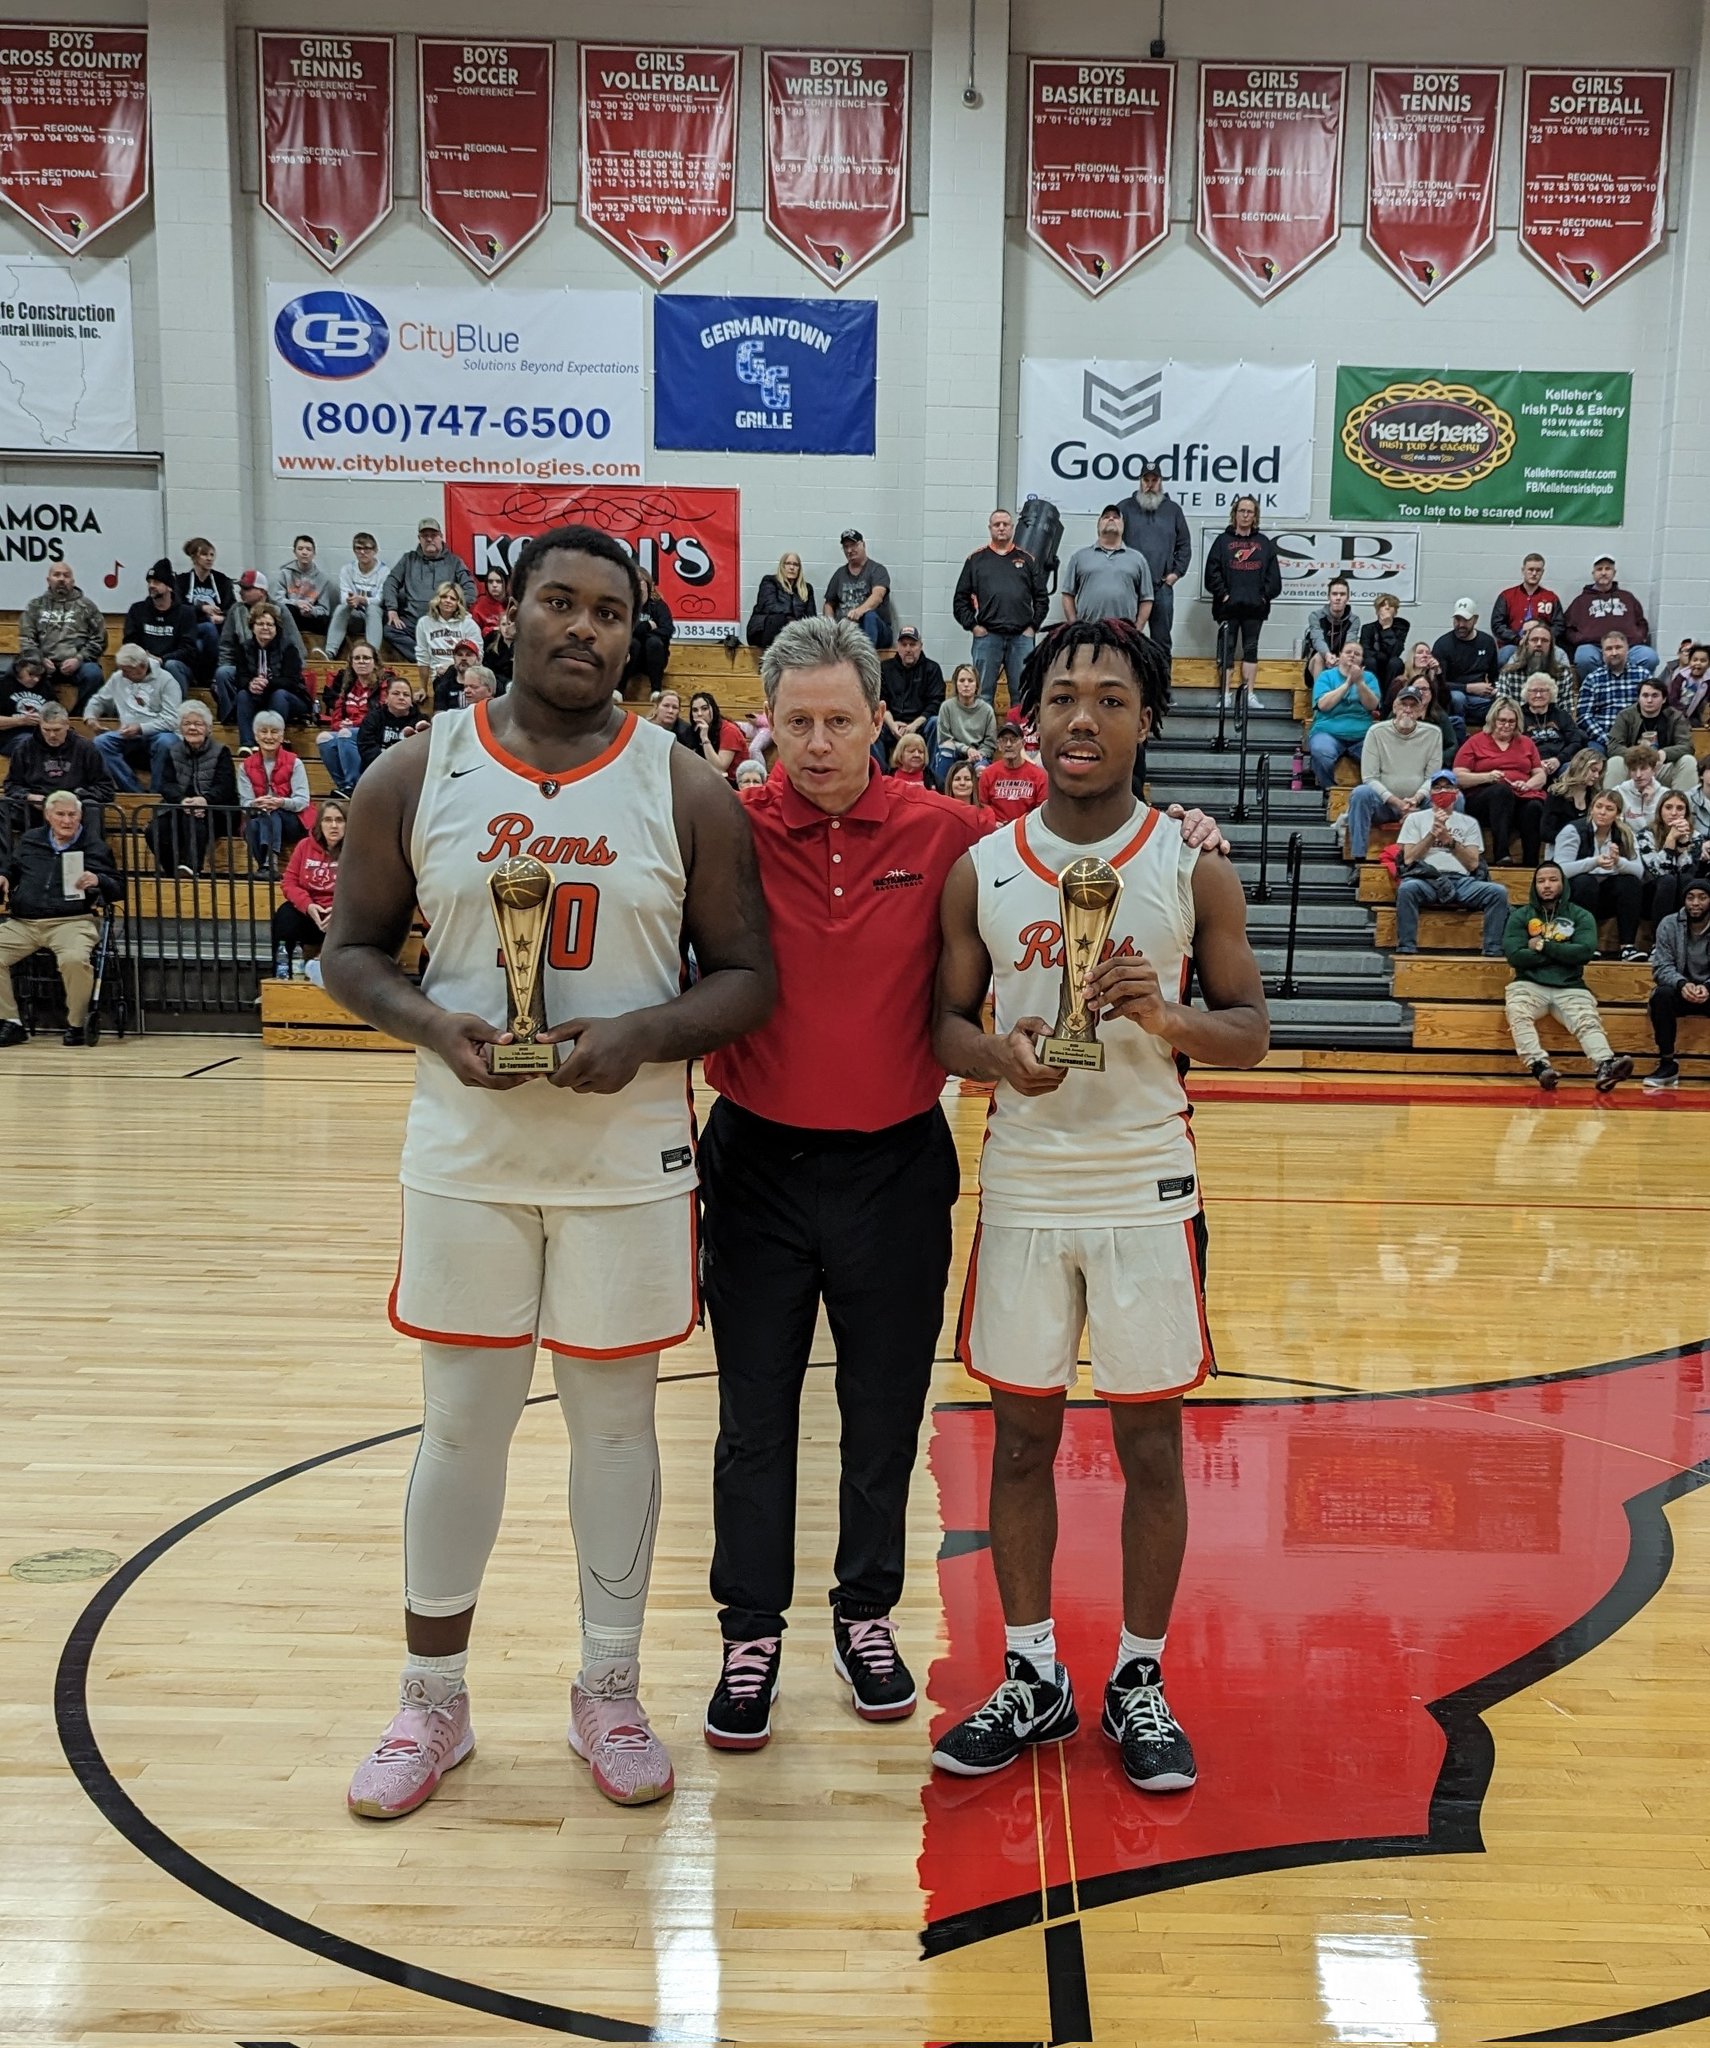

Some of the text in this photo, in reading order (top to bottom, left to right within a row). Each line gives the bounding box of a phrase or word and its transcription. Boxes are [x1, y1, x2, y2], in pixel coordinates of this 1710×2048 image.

[48, 32, 94, 49] BOYS
[300, 40, 353, 59] GIRLS
[0, 49, 143, 69] CROSS COUNTRY
[463, 47, 508, 65] BOYS
[635, 52, 685, 71] GIRLS
[290, 60, 363, 79] TENNIS
[809, 58, 863, 77] BOYS
[35, 69, 104, 79] CONFERENCE
[453, 66, 519, 85] SOCCER
[1078, 67, 1125, 86] BOYS
[1247, 71, 1299, 89] GIRLS
[297, 80, 355, 91] CONFERENCE
[600, 71, 720, 92] VOLLEYBALL
[785, 78, 888, 97] WRESTLING
[1413, 74, 1459, 92] BOYS
[1572, 77, 1623, 95] GIRLS
[457, 87, 514, 97] CONFERENCE
[625, 92, 693, 103] CONFERENCE
[1041, 85, 1160, 106] BASKETBALL
[804, 99, 866, 109] CONFERENCE
[1212, 89, 1331, 110] BASKETBALL
[1400, 94, 1472, 112] TENNIS
[1549, 96, 1643, 114] SOFTBALL
[604, 111, 617, 120] '21
[620, 111, 634, 120] '22
[1069, 107, 1131, 117] CONFERENCE
[1240, 111, 1300, 121] CONFERENCE
[1049, 115, 1061, 125] '01
[1081, 116, 1097, 126] '19
[1098, 117, 1112, 126] '22
[1405, 114, 1462, 124] CONFERENCE
[1563, 116, 1626, 126] CONFERENCE
[44, 124, 95, 133] REGIONAL
[1545, 125, 1558, 134] '03
[1560, 126, 1573, 135] '04
[1604, 127, 1618, 136] '10
[1620, 127, 1632, 135] '11
[1634, 127, 1650, 136] '12
[31, 133, 45, 142] '03
[47, 133, 62, 142] '04
[64, 134, 79, 142] '05
[81, 134, 96, 143] '06
[1529, 134, 1542, 143] '22
[303, 147, 351, 157] SECTIONAL
[464, 143, 508, 154] REGIONAL
[633, 149, 684, 159] REGIONAL
[440, 152, 454, 160] '11
[42, 168, 98, 178] SECTIONAL
[1074, 163, 1121, 173] REGIONAL
[1245, 167, 1291, 176] REGIONAL
[1567, 173, 1614, 182] REGIONAL
[1408, 181, 1453, 190] SECTIONAL
[463, 189, 510, 199] SECTIONAL
[631, 195, 687, 205] SECTIONAL
[1526, 195, 1538, 203] '11
[1541, 195, 1554, 204] '12
[1555, 195, 1570, 204] '13
[1570, 195, 1586, 204] '14
[1604, 195, 1616, 204] '21
[1617, 195, 1631, 204] '22
[808, 200, 860, 210] SECTIONAL
[597, 212, 625, 221] '21 '22
[1071, 208, 1122, 219] SECTIONAL
[1241, 212, 1292, 222] SECTIONAL
[1562, 218, 1614, 228] SECTIONAL
[1555, 227, 1570, 236] '10
[1571, 228, 1585, 237] '22
[18, 302, 116, 322] Construction
[0, 323, 101, 339] ntral Illinois, Inc.
[292, 313, 372, 358] CB
[700, 315, 832, 355] GERMANTOWN
[399, 321, 520, 358] CityBlue
[463, 359, 640, 375] Solutions Beyond Expectations
[1545, 388, 1603, 401] Kelleher's
[1521, 403, 1625, 418] Irish Pub & Eatery
[301, 402, 612, 443] (800)747-6500
[735, 410, 793, 429] GRILLE
[1558, 418, 1567, 426] W
[1568, 418, 1592, 427] Water
[1593, 418, 1604, 427] St.
[1370, 420, 1489, 443] Kelleher's
[1540, 428, 1569, 438] Peoria,
[1570, 429, 1579, 437] IL
[278, 453, 641, 478] www.citybluetechnologies.com
[1050, 440, 1281, 484] Goodfield
[1524, 467, 1617, 479] Kellehersonwater.com
[1526, 481, 1614, 496] FB/Kellehersirishpub
[1398, 504, 1554, 519] Too late to be scared now!
[1279, 560, 1407, 570] STATE BANK
[1537, 601, 1553, 615] 20
[684, 625, 736, 637] 383-4551
[476, 812, 618, 866] Rams
[496, 882, 600, 971] 0
[1013, 920, 1143, 971] Rs
[1186, 1182, 1192, 1190] S
